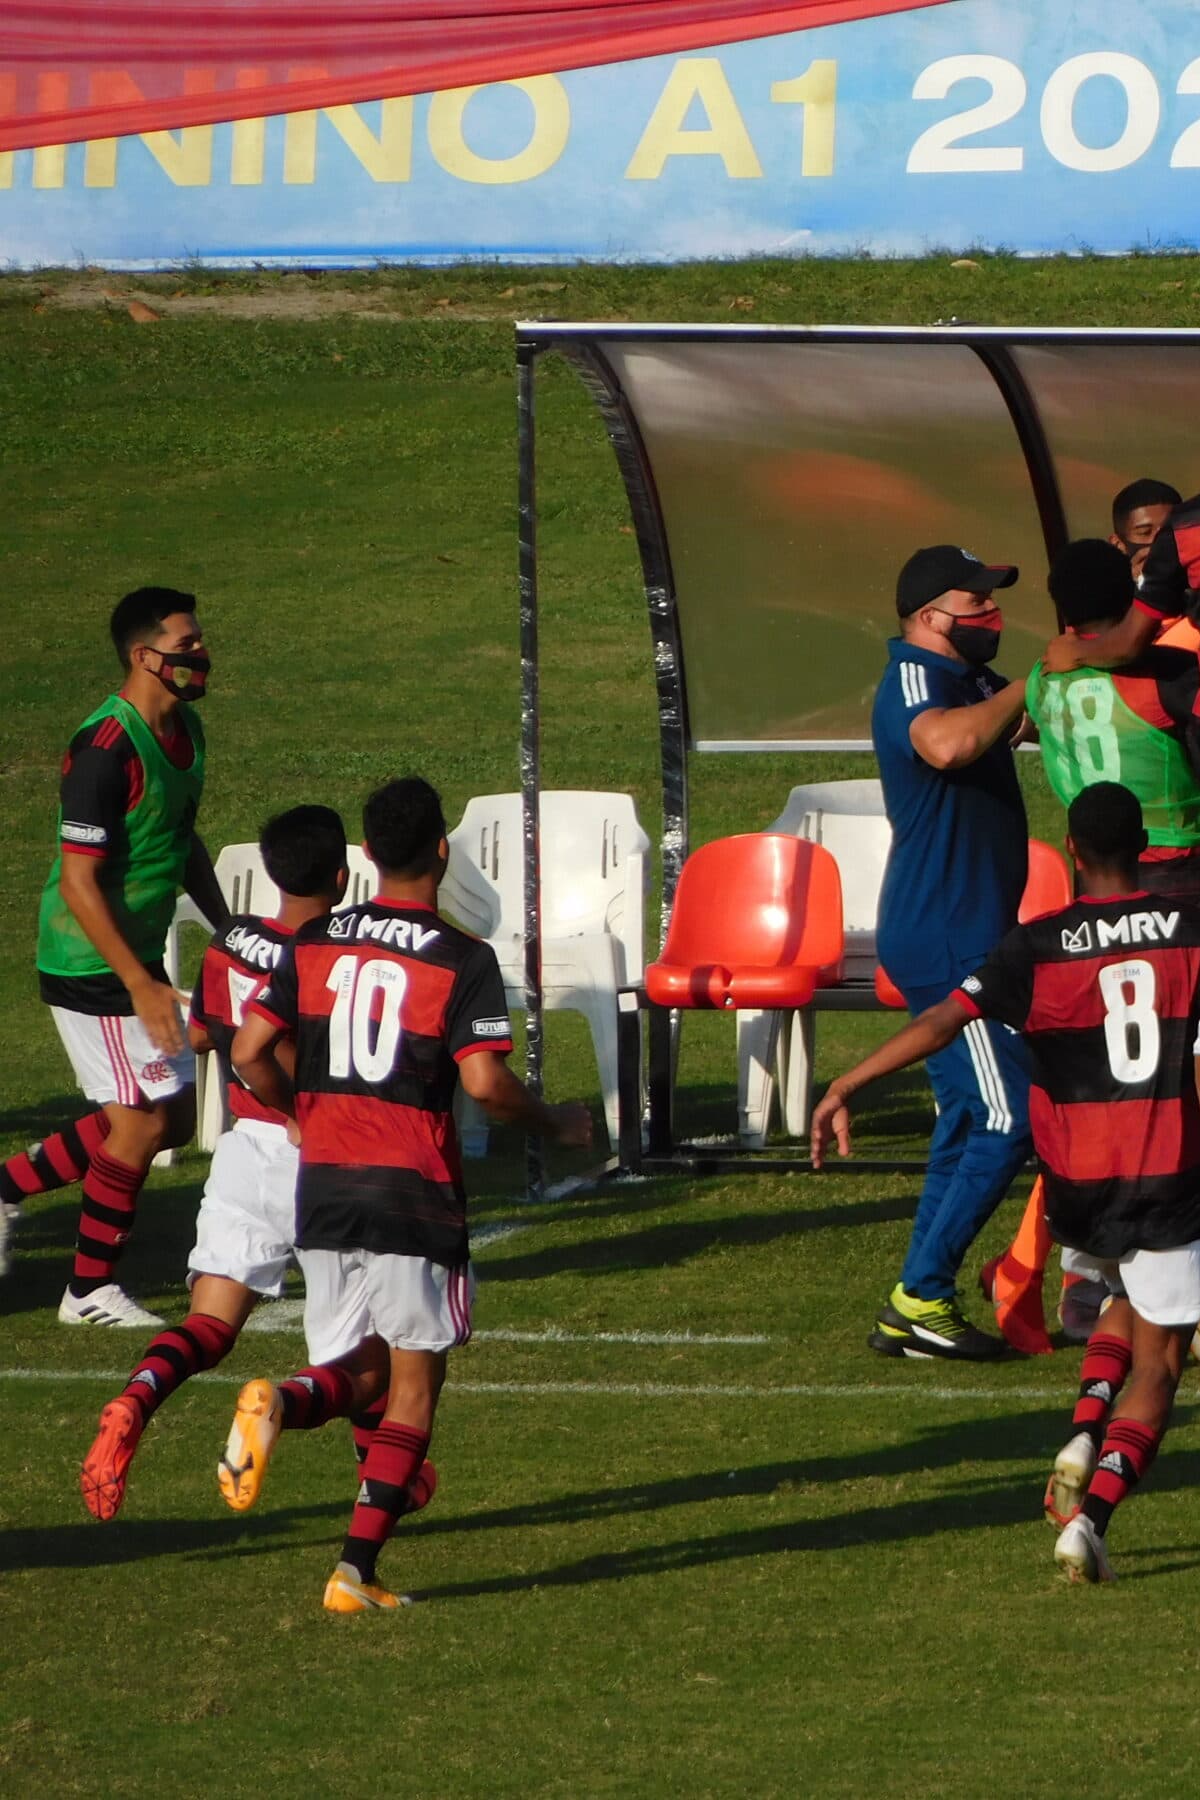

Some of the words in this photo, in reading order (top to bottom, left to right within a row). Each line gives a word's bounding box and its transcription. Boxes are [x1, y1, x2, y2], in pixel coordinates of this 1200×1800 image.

[0, 68, 570, 189] ININO
[624, 58, 838, 180] A1
[356, 914, 440, 951] MRV
[1096, 911, 1180, 948] MRV
[325, 954, 407, 1082] 10
[1098, 959, 1160, 1083] 8
